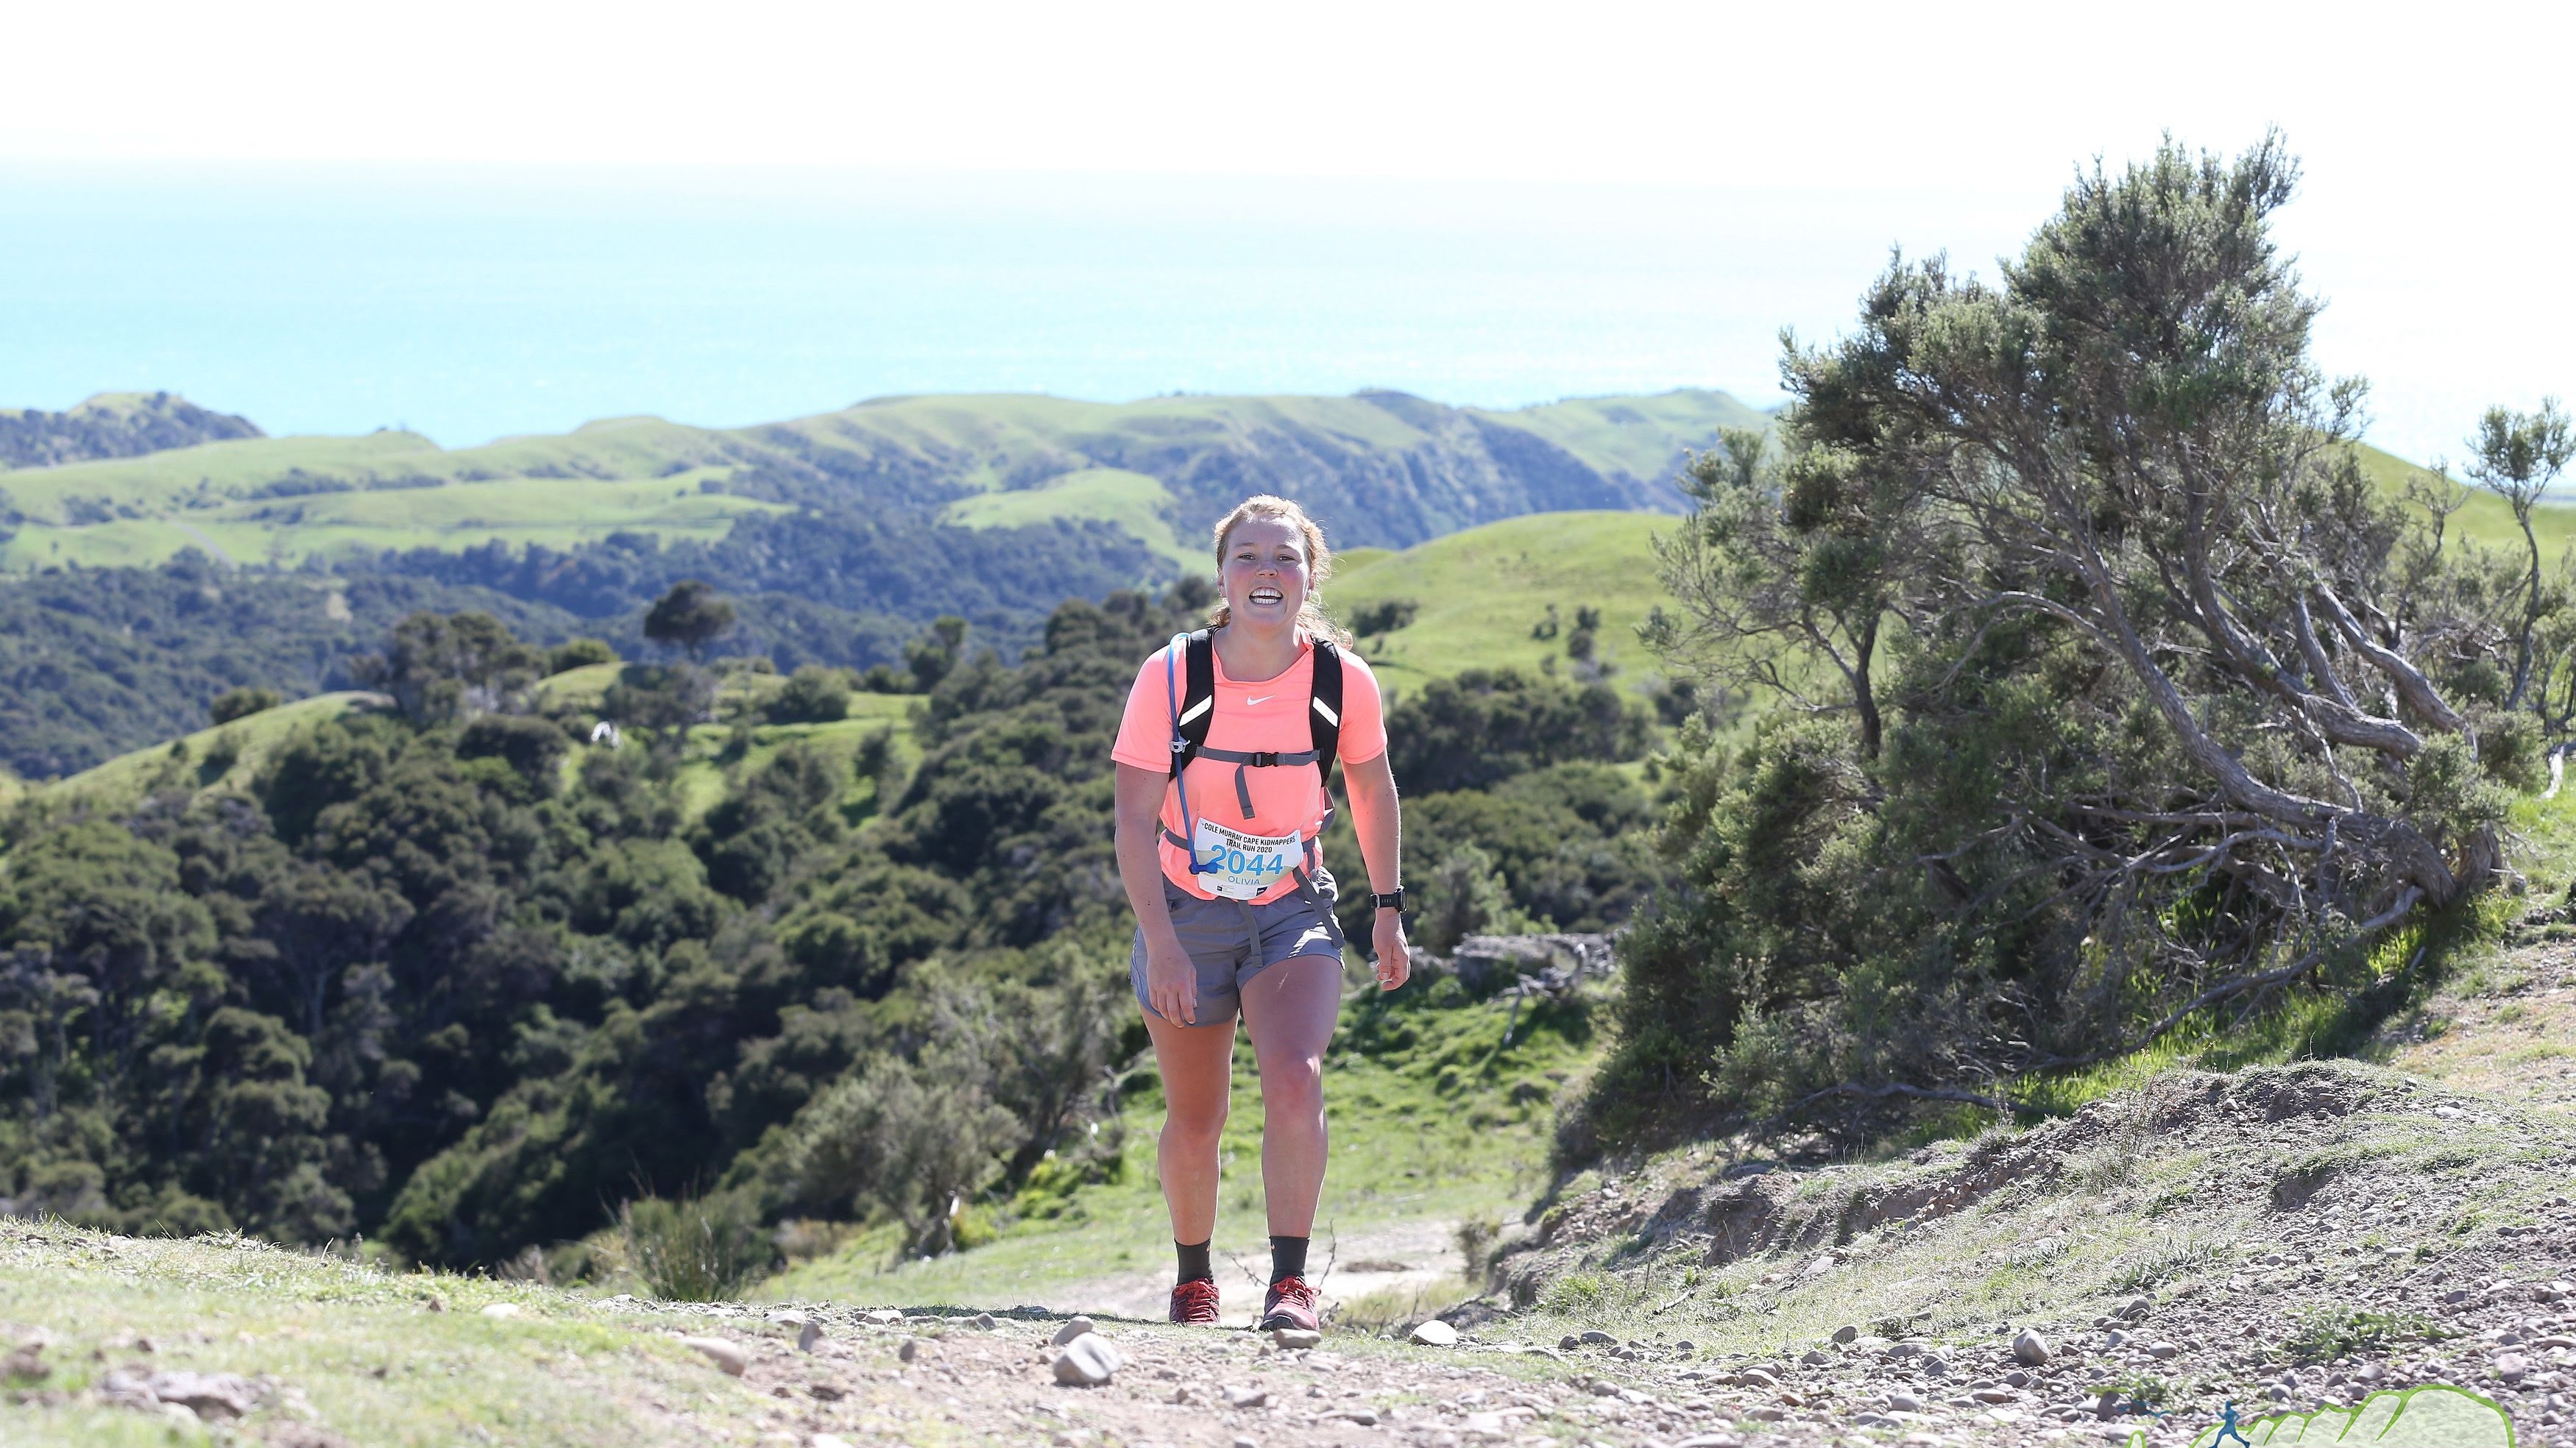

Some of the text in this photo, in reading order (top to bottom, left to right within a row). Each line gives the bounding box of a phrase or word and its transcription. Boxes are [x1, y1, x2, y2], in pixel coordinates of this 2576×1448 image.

[1204, 823, 1295, 846] COLE MURRAY CAPE KIDNAPPERS
[1226, 839, 1242, 850] TRAIL
[1242, 844, 1256, 852] RUN
[1211, 845, 1283, 876] 2044
[1228, 876, 1260, 884] OLIVIA
